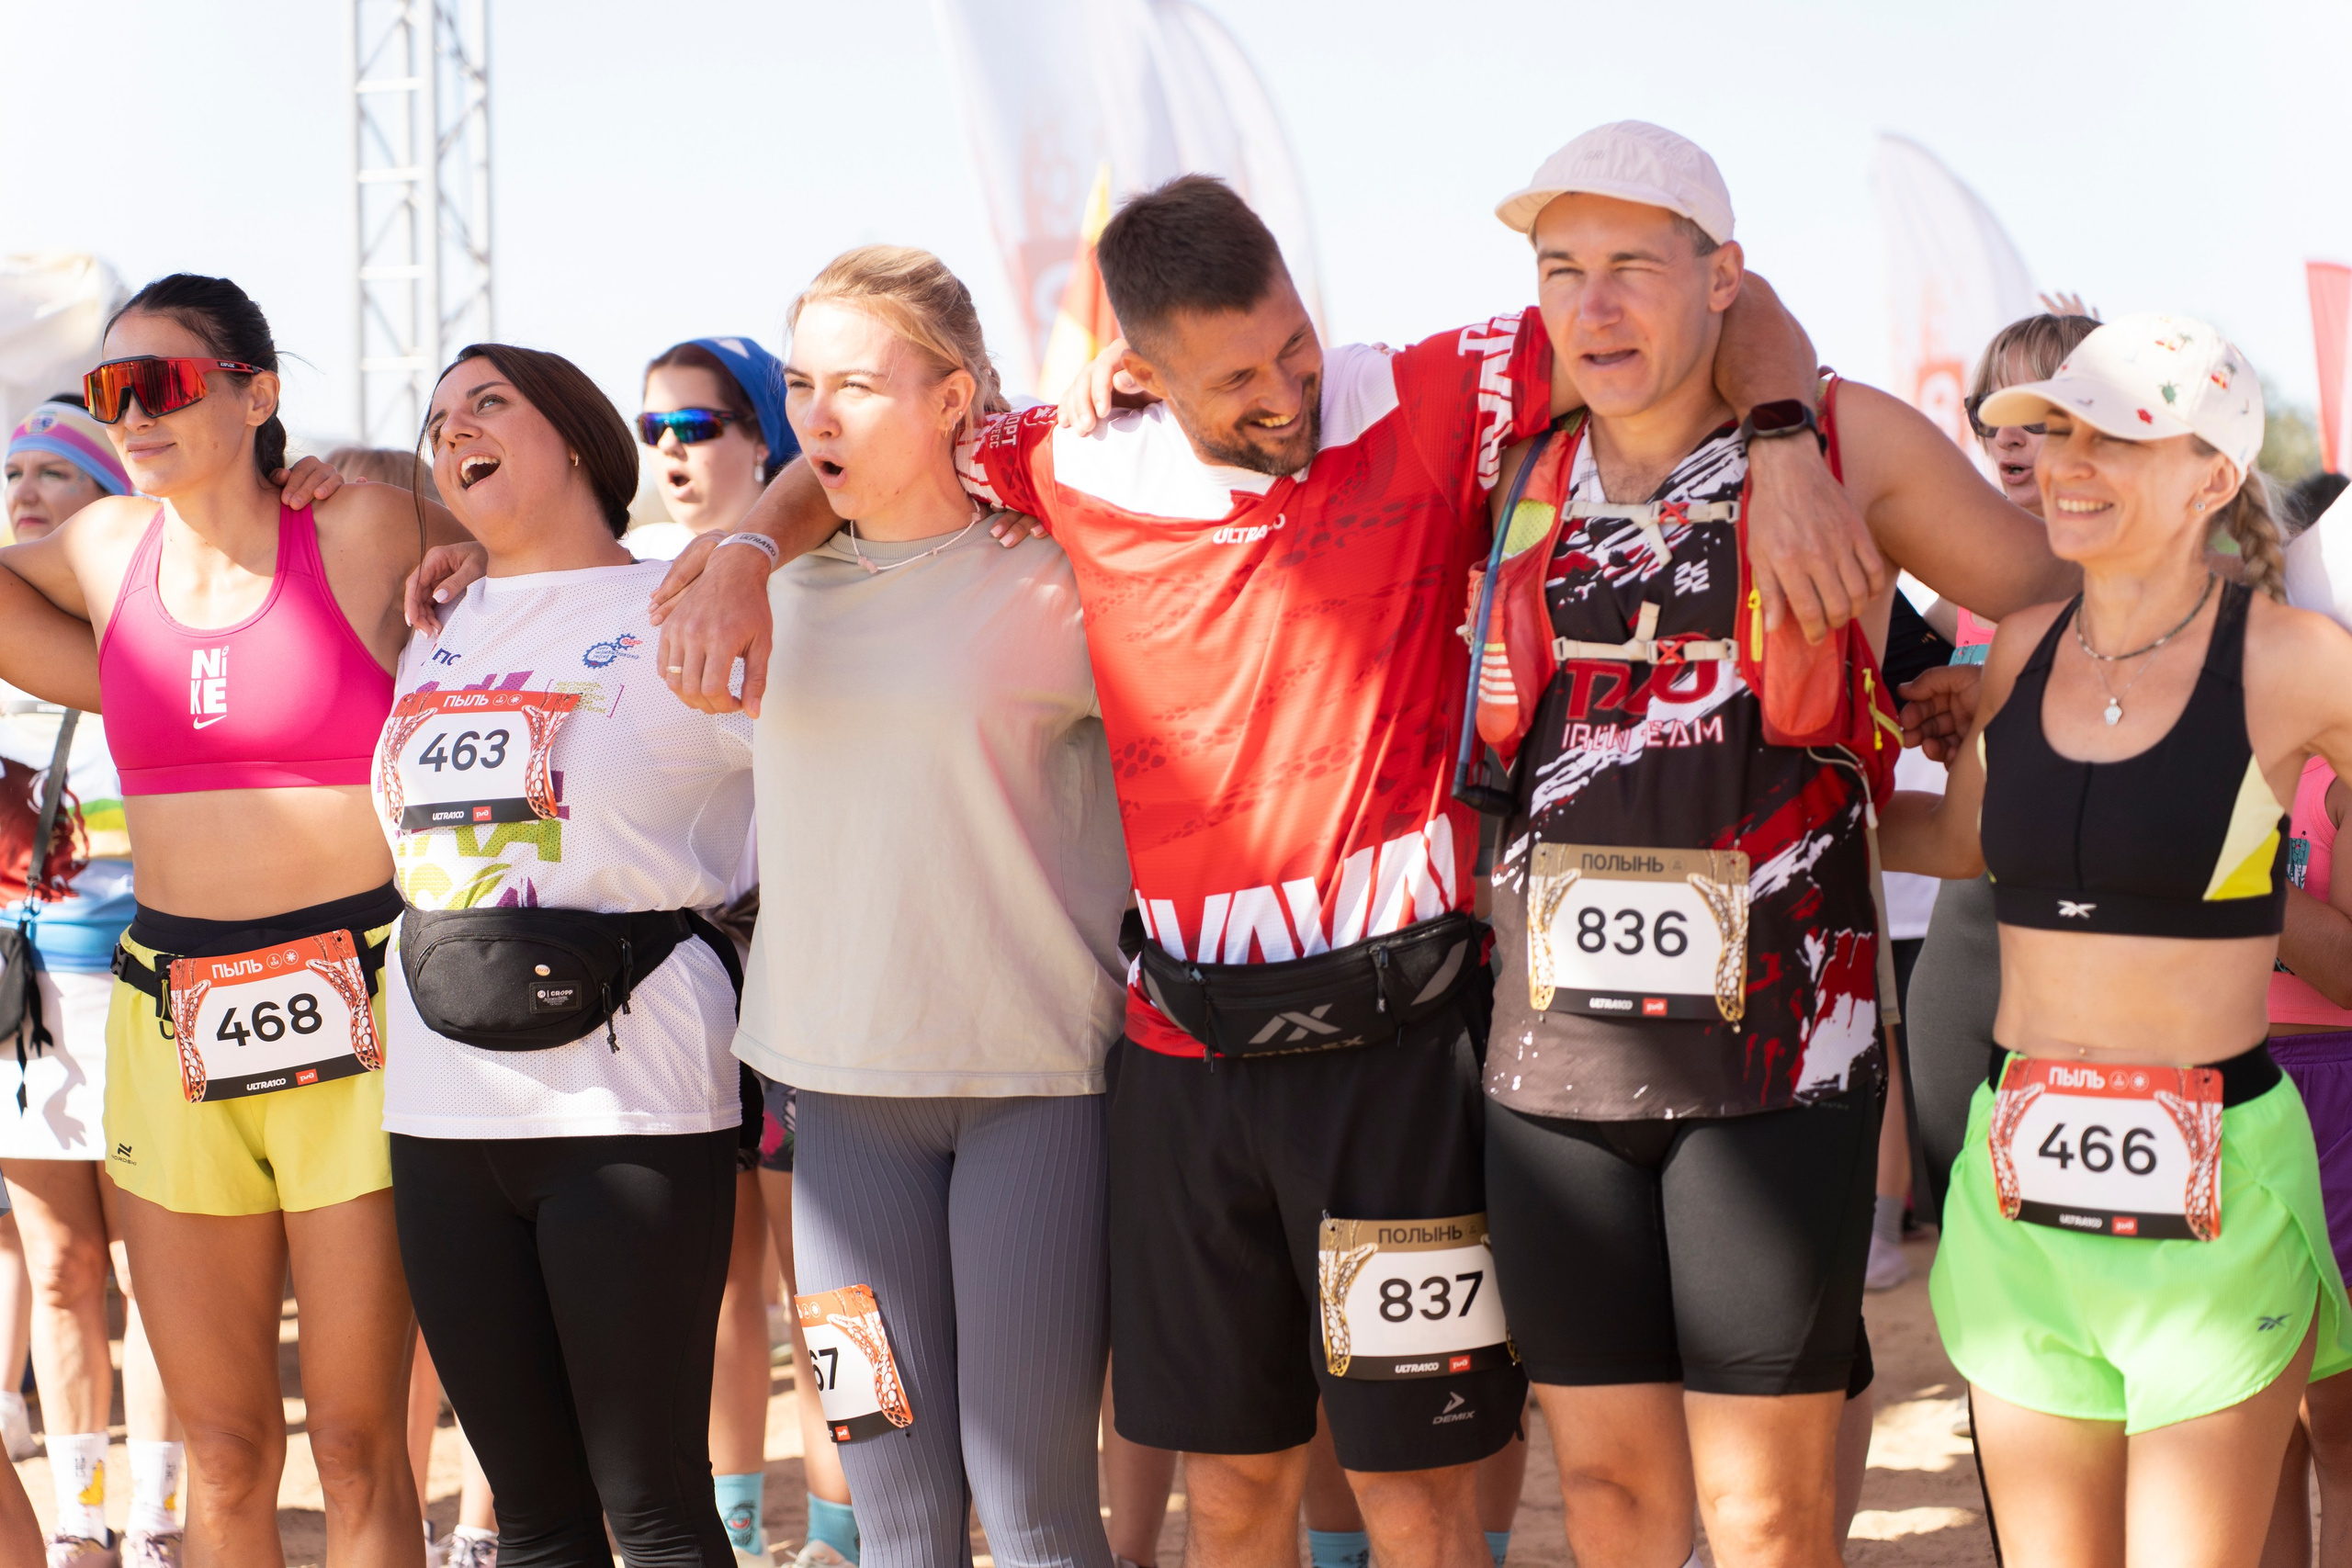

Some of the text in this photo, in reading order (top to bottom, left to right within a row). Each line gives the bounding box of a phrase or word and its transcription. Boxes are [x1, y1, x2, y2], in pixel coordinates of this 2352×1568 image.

[1212, 512, 1285, 545] ULTRA0
[443, 694, 489, 708] ПЫЛЬ
[418, 728, 510, 773] 463
[432, 810, 465, 821] ULTRA100
[1580, 853, 1665, 874] ПОЛЫНЬ
[1577, 907, 1688, 957] 836
[210, 959, 264, 979] ПЫЛЬ
[216, 993, 322, 1047] 468
[246, 1077, 287, 1091] ULTRA100
[2048, 1066, 2106, 1089] ПЫЛЬ
[2038, 1122, 2158, 1177] 466
[1378, 1225, 1463, 1244] ПОЛЫНЬ
[1379, 1270, 1484, 1324] 837
[808, 1347, 839, 1392] 67
[1395, 1361, 1440, 1374] ULTRA100
[1432, 1411, 1476, 1425] DEMIX
